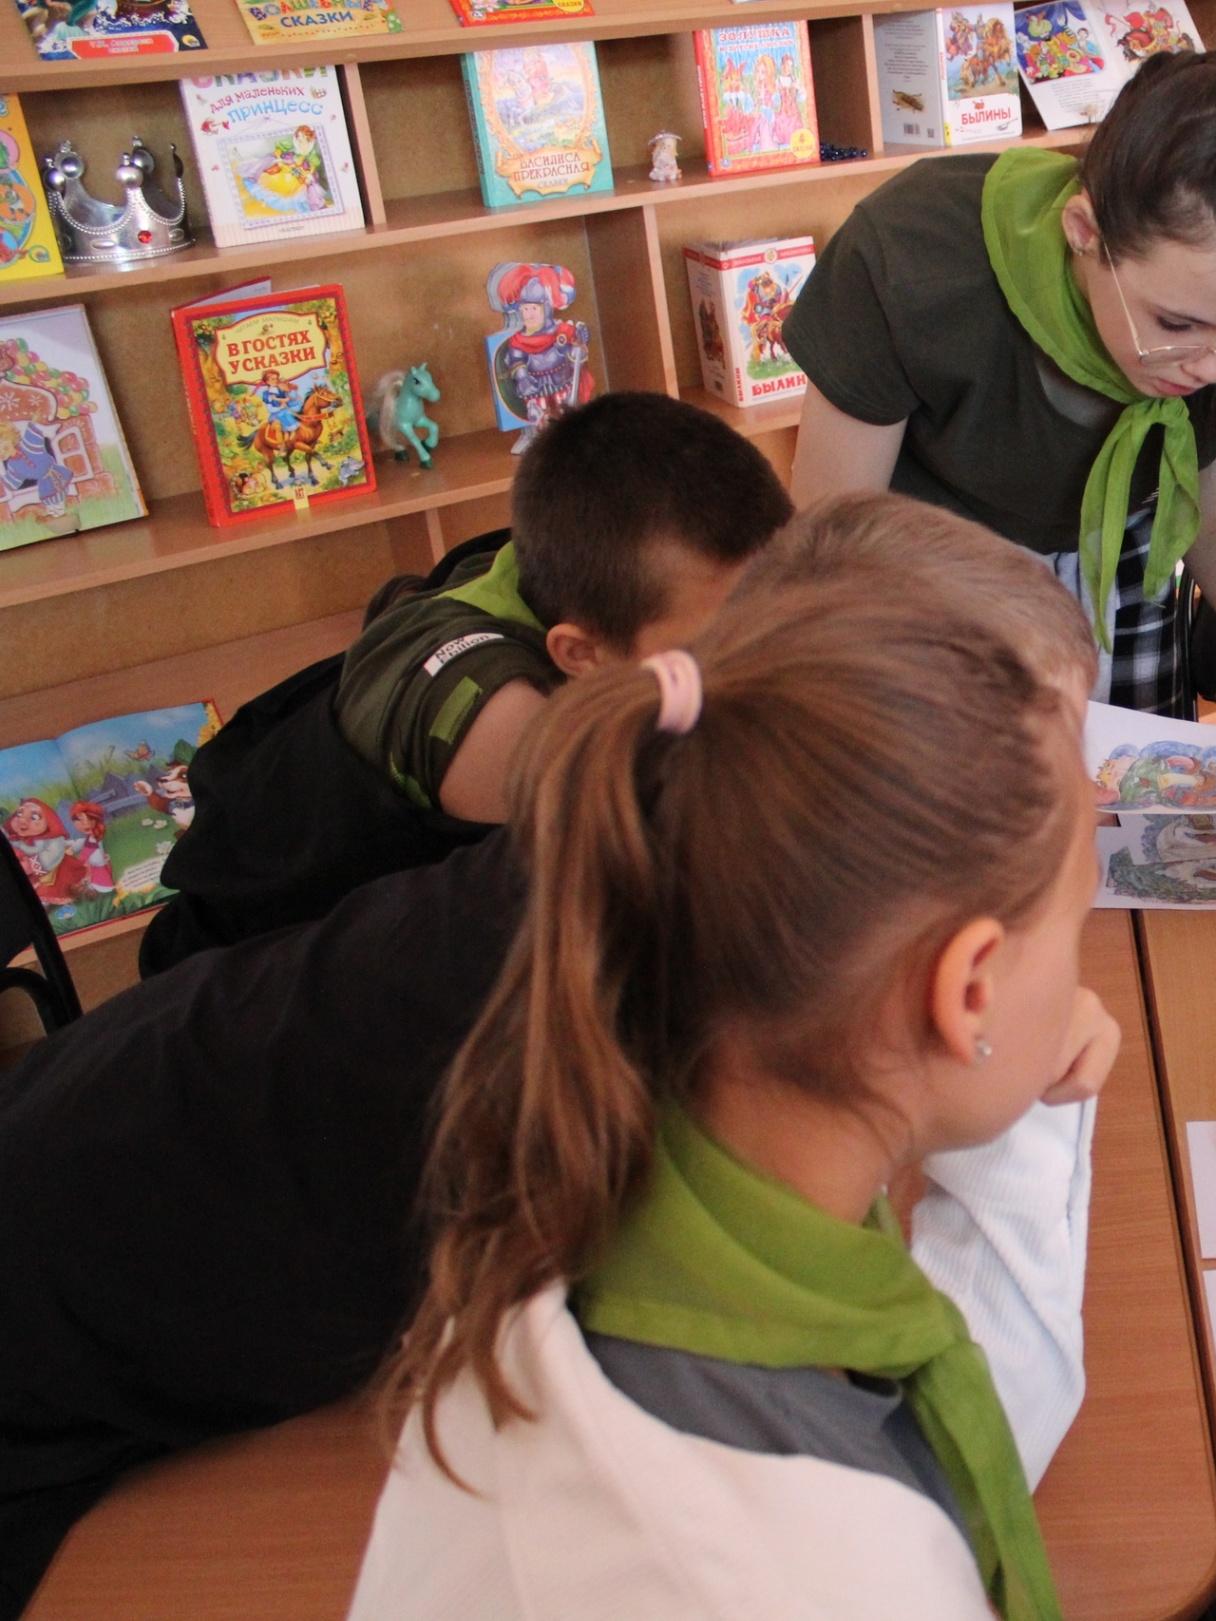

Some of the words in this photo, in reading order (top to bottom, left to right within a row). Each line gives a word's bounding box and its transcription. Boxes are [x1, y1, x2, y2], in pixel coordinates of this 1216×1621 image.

[280, 11, 353, 27] СКАЗКИ
[961, 107, 1011, 126] БЫЛИНЫ
[513, 162, 591, 182] ПРЕКРАСНАЯ
[226, 342, 239, 357] В
[241, 329, 312, 354] ГОСТЯХ
[228, 359, 240, 375] У
[241, 346, 317, 372] СКАЗКИ
[752, 374, 807, 397] БЫЛИН
